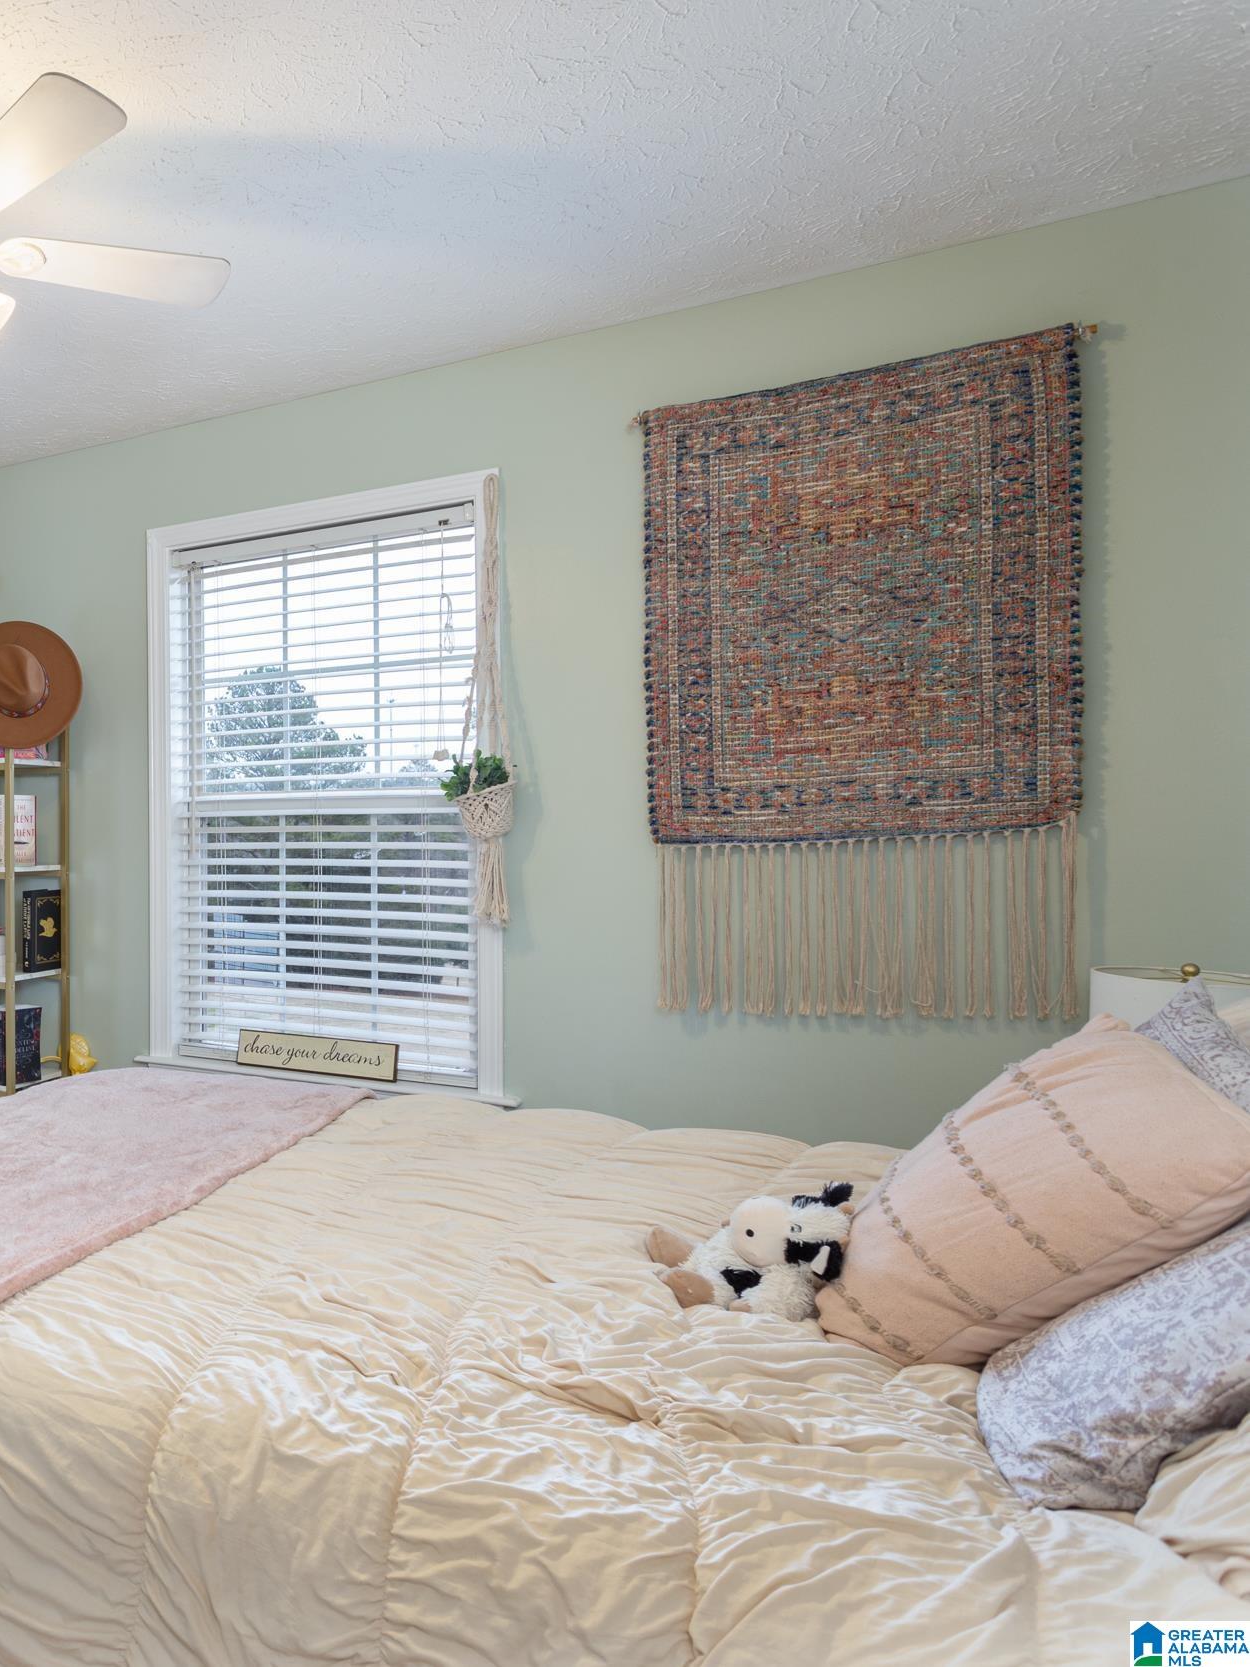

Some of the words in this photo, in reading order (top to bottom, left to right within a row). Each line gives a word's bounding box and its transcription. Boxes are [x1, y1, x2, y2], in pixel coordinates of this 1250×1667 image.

[244, 1035, 284, 1056] chase
[281, 1048, 320, 1066] your
[323, 1041, 384, 1067] dreams
